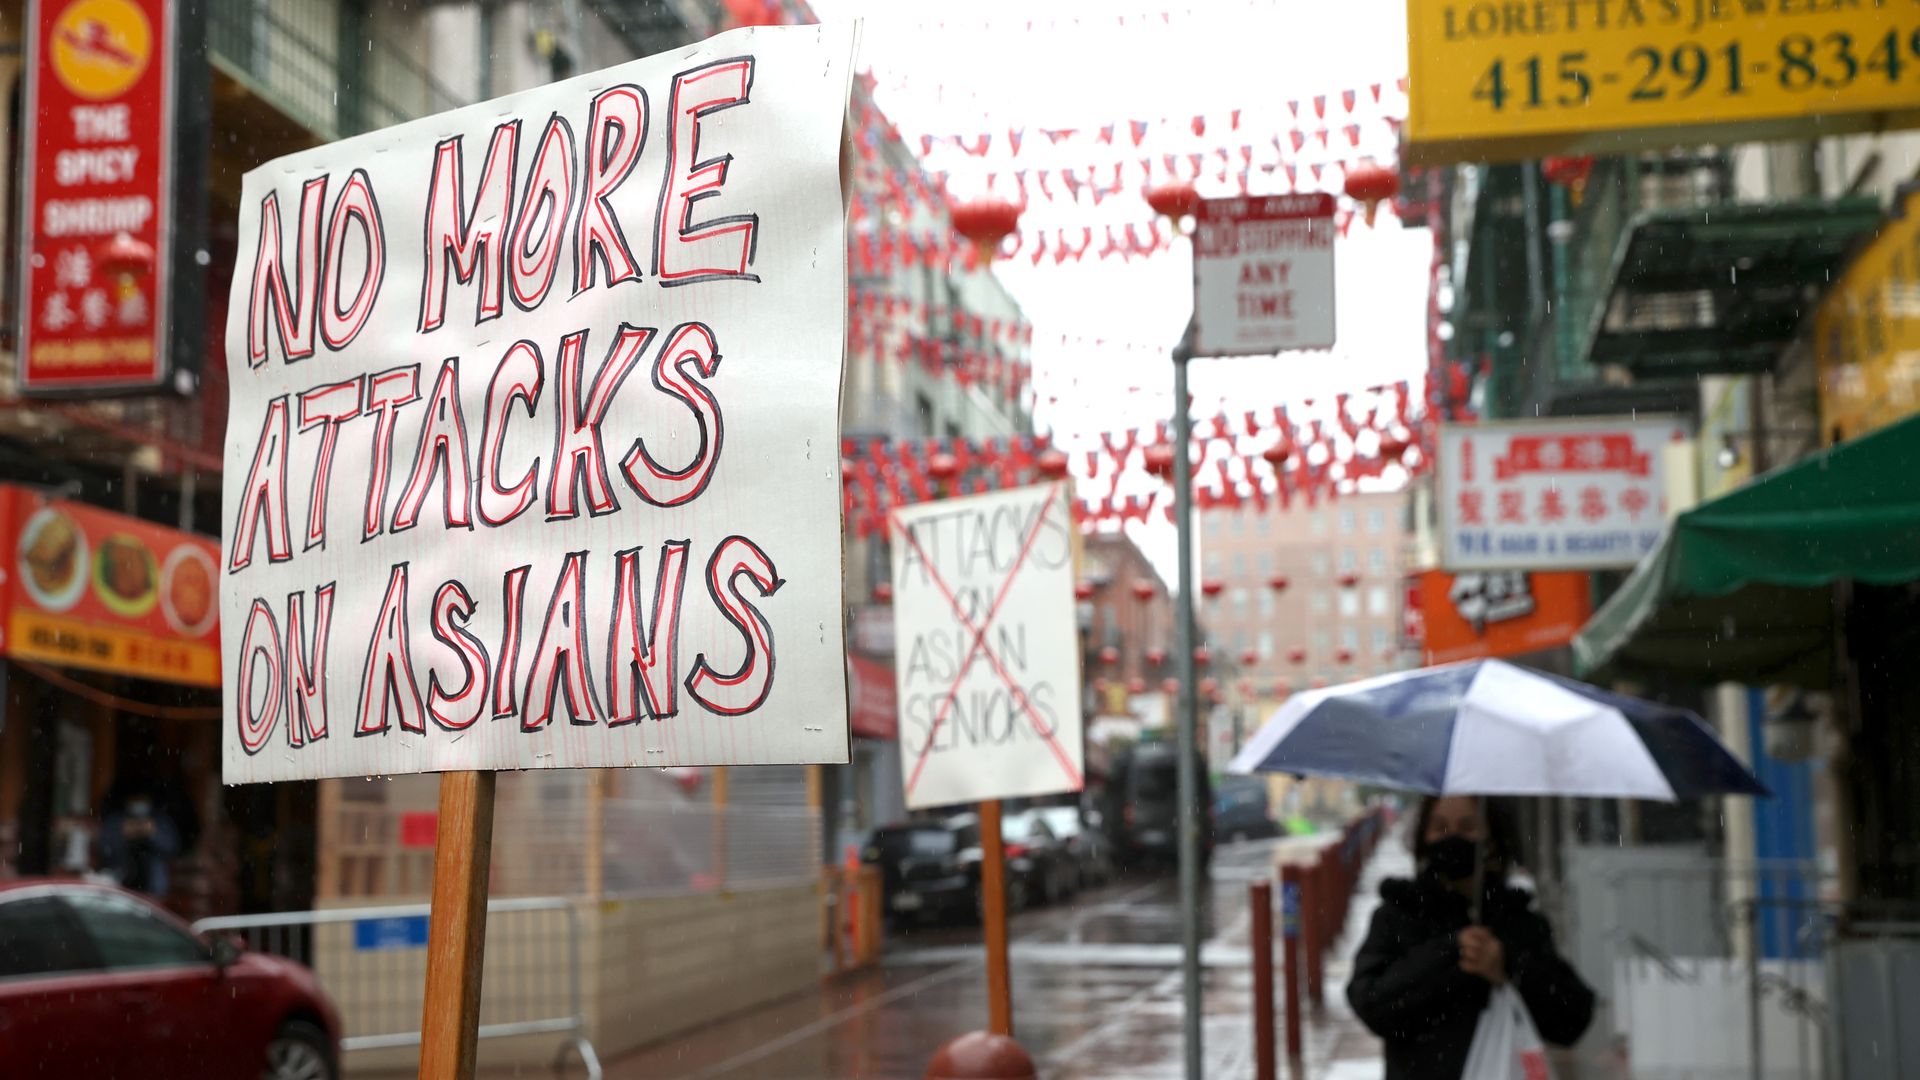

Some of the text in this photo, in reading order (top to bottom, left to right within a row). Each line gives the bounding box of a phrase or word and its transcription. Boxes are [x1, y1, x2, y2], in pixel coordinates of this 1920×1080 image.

[1443, 0, 1681, 41] LORETTAS
[1471, 27, 1920, 111] 415-291-834
[69, 103, 132, 143] THE
[55, 146, 140, 186] SPICY
[43, 195, 153, 237] SHRIMP
[248, 55, 761, 368] NO MORE
[1238, 259, 1294, 285] ANY
[1236, 290, 1296, 320] TIME
[229, 321, 724, 574] ATTACKS
[899, 500, 1071, 590] ATTACKS
[952, 585, 996, 626] ON
[236, 580, 336, 756] ON
[353, 535, 786, 739] ASIANS
[904, 623, 1028, 688] ASIAN
[904, 681, 1060, 758] SENIORS
